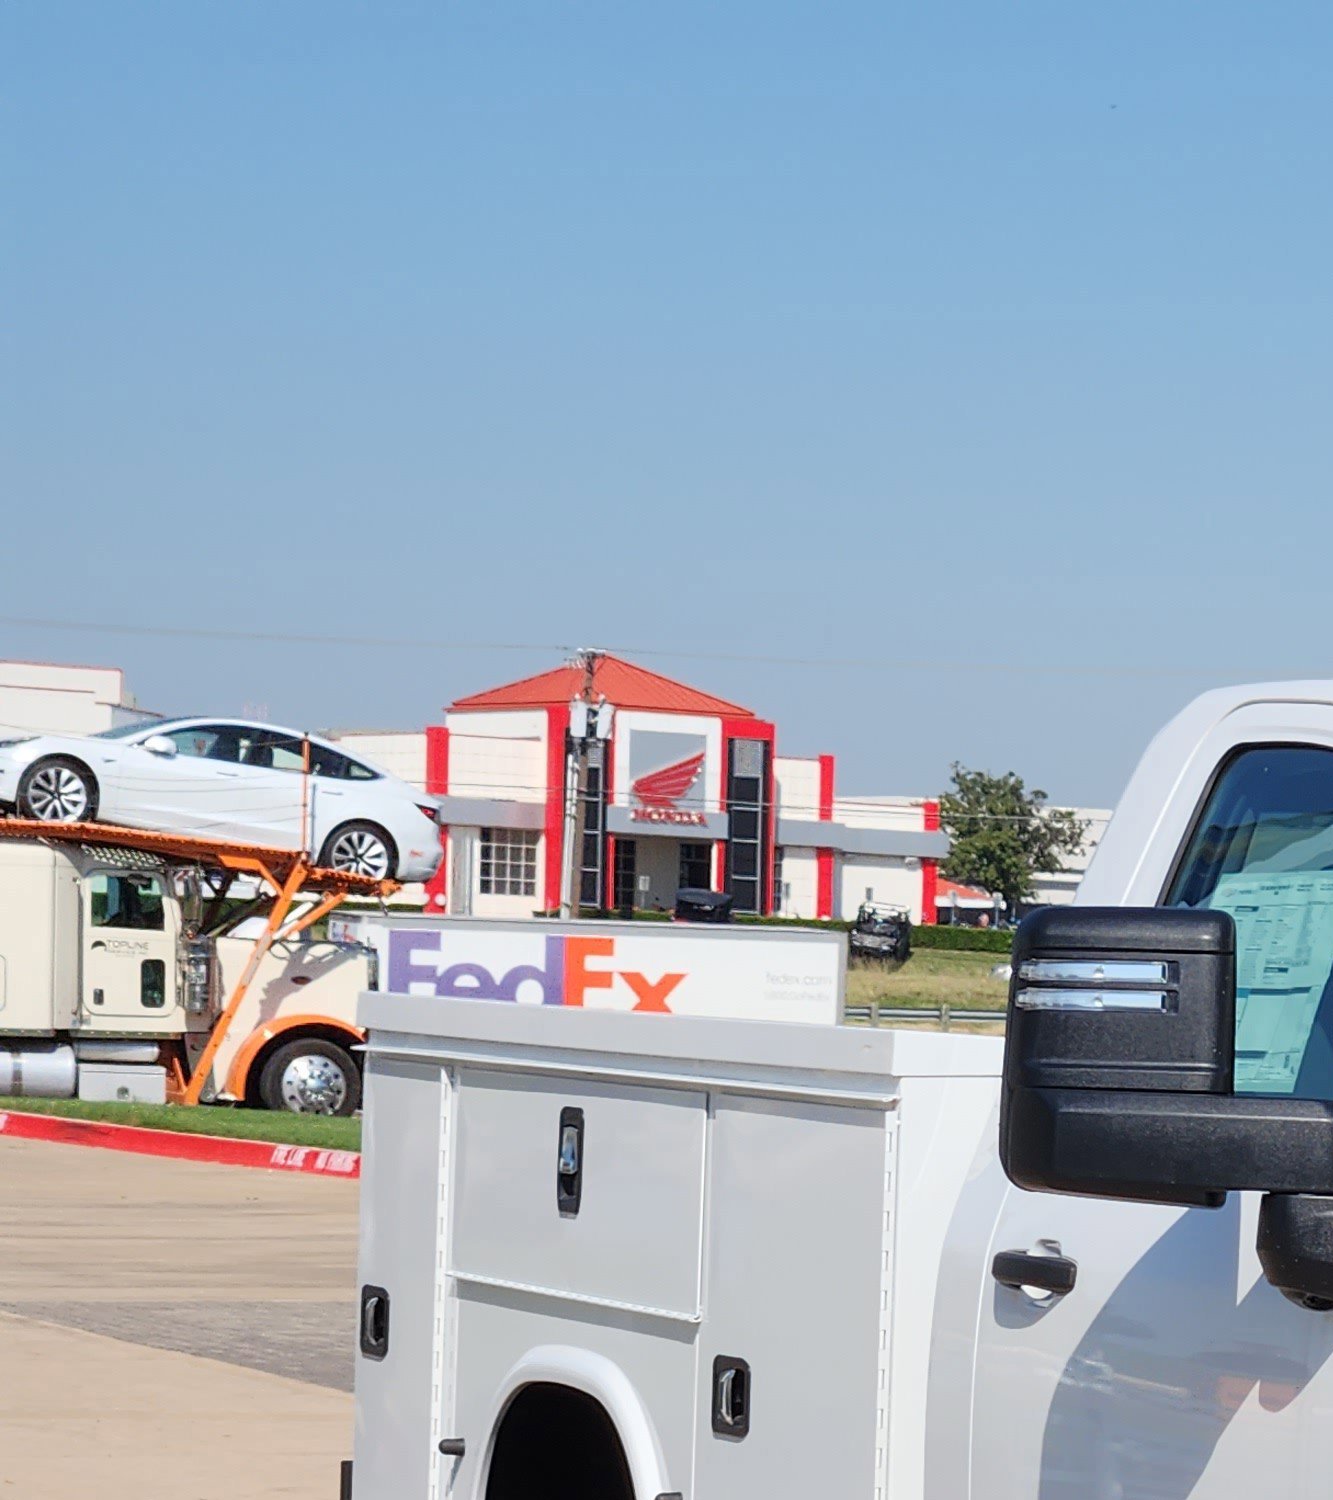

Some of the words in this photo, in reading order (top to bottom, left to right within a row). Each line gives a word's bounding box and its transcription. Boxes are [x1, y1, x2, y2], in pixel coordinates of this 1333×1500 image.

[630, 807, 708, 826] HONDA
[107, 940, 149, 951] TOPLINE
[388, 929, 689, 1014] FedEx
